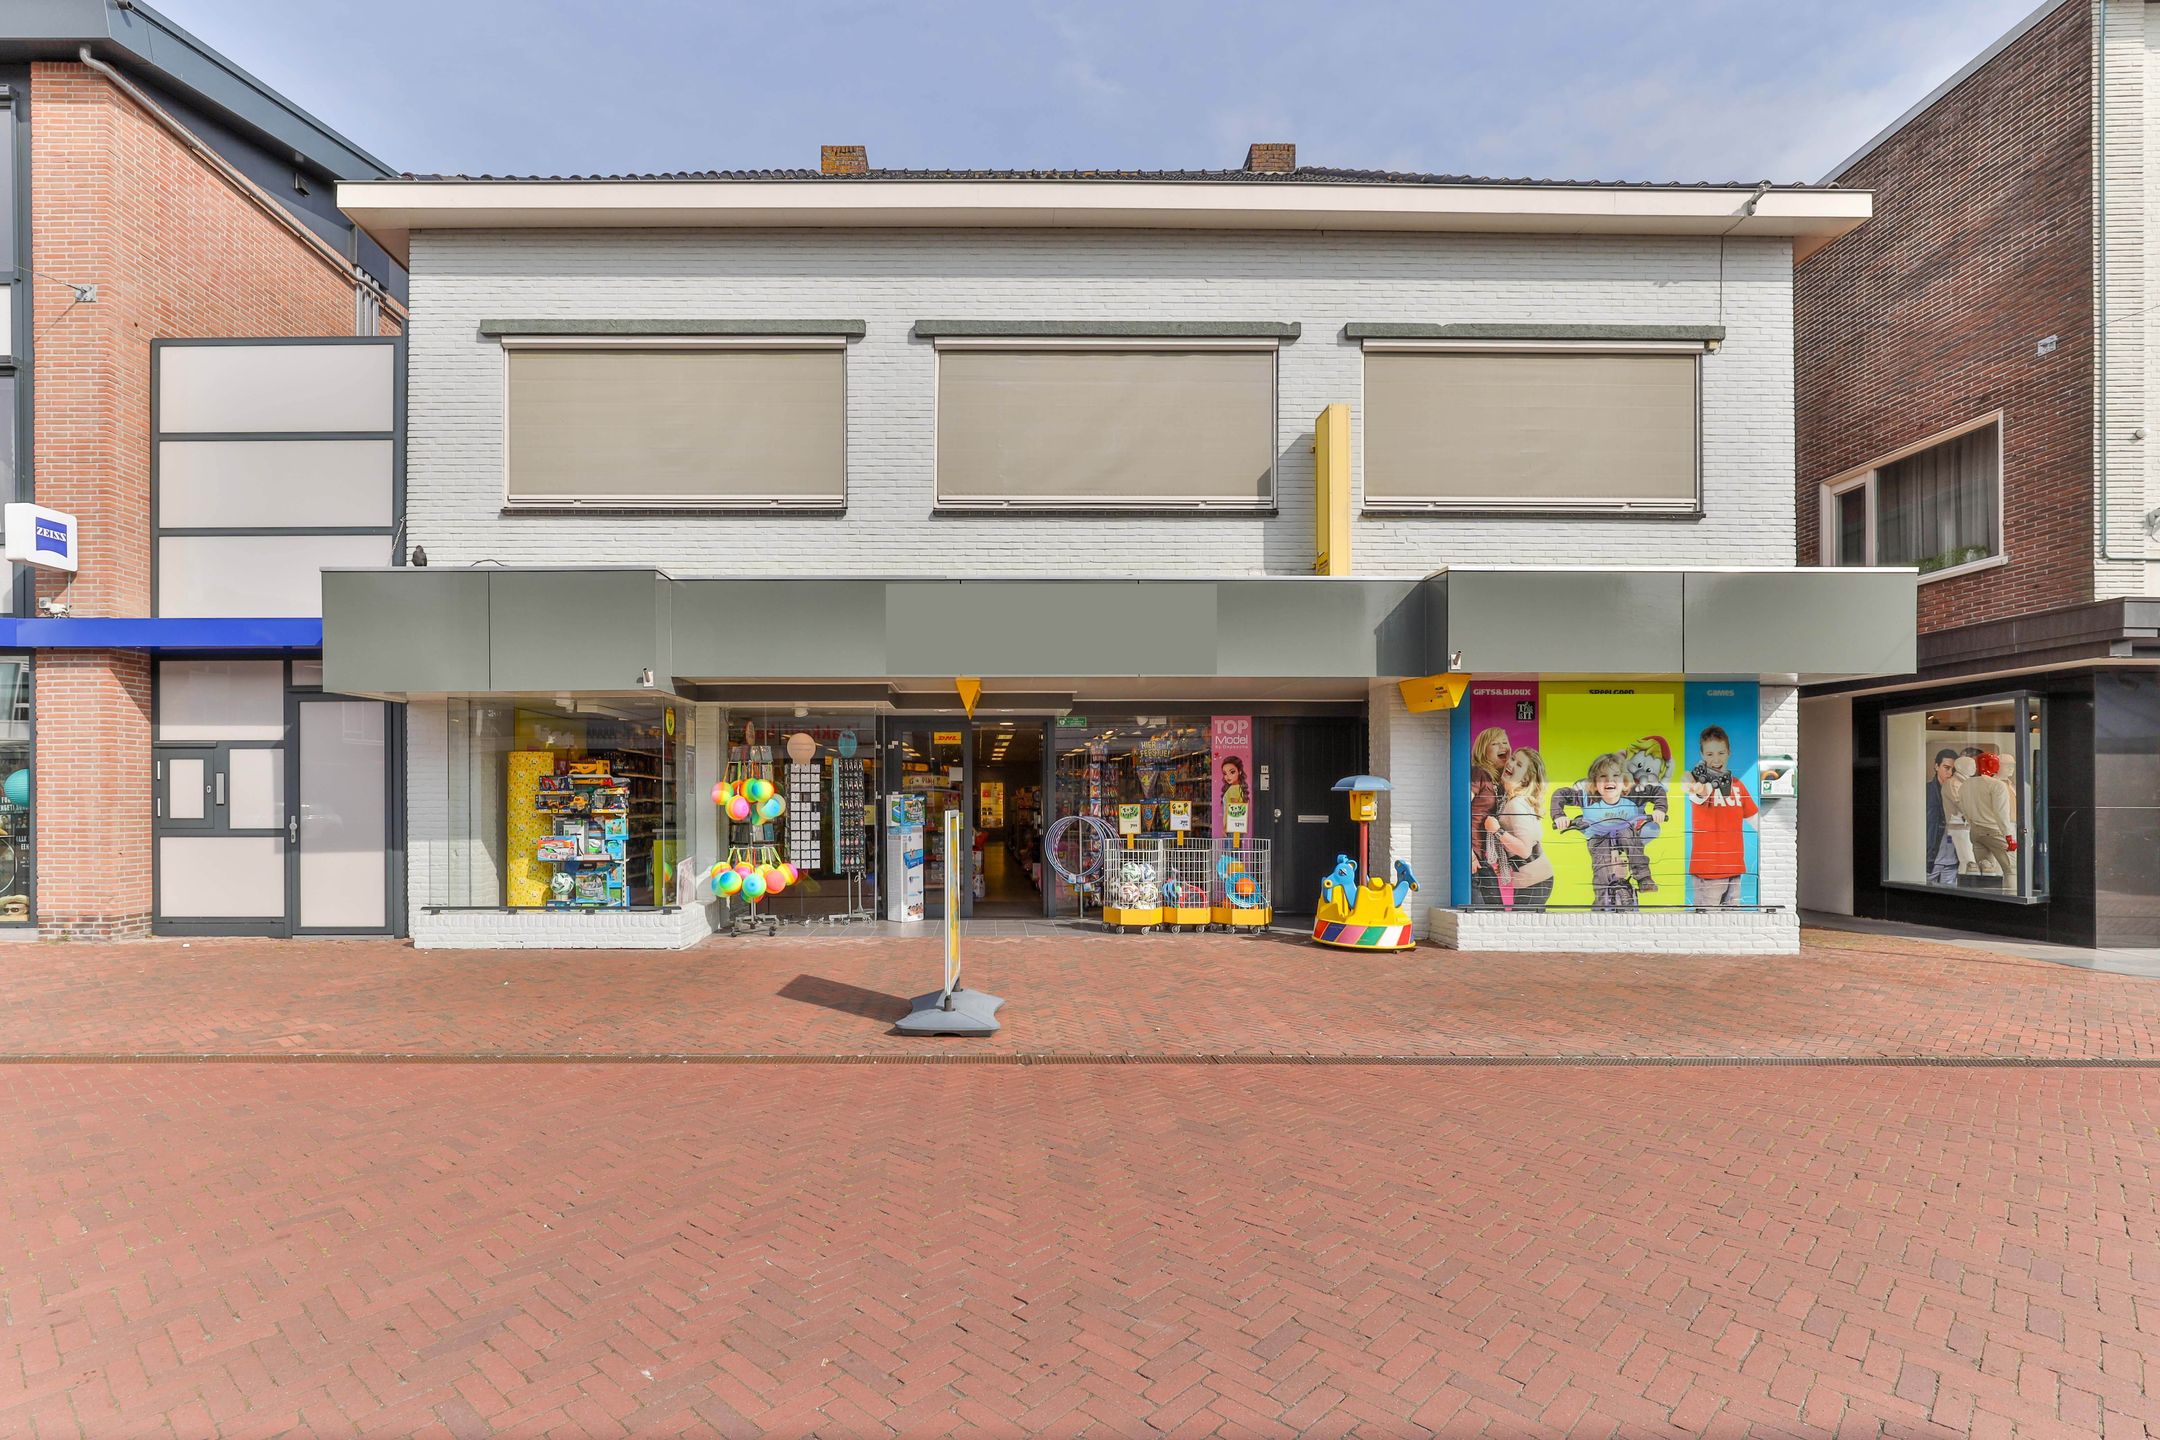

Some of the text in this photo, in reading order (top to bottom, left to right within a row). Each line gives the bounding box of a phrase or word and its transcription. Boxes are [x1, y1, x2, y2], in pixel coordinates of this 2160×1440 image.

[36, 526, 67, 542] ZEISS
[1215, 719, 1249, 735] TOP
[1215, 735, 1249, 746] Model
